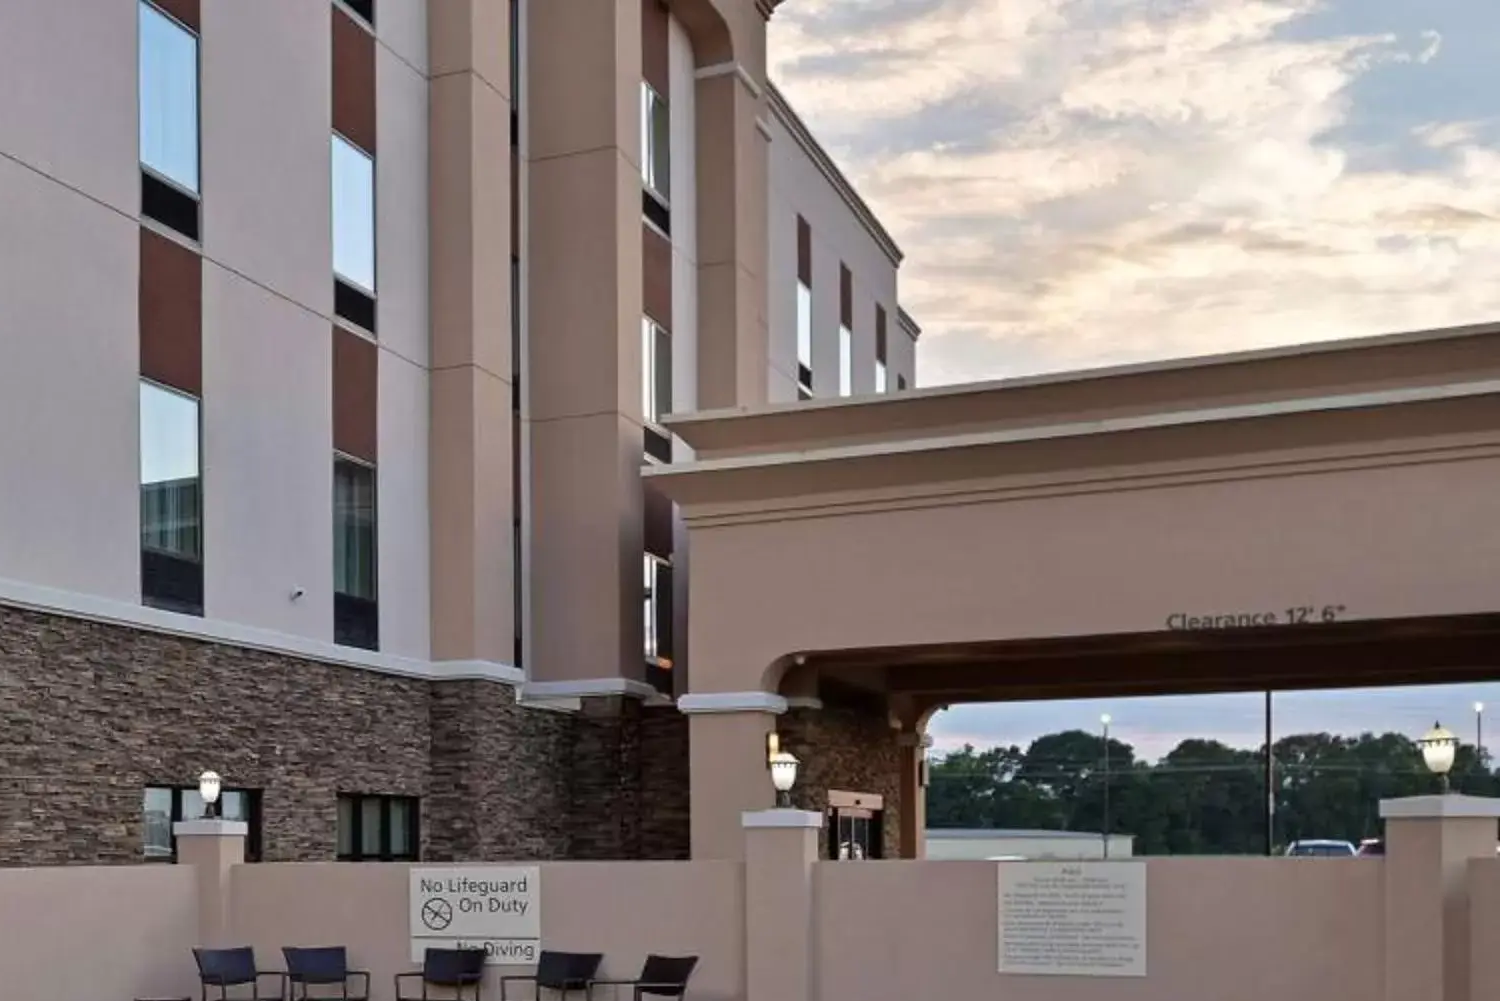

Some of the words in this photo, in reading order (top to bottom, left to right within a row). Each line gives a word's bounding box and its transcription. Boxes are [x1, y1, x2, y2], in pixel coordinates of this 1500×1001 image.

[1166, 610, 1276, 631] Clearance
[420, 879, 443, 893] No
[448, 877, 528, 896] Lifeguard
[459, 897, 483, 913] On
[489, 897, 529, 916] Duty
[483, 940, 535, 961] Diving
